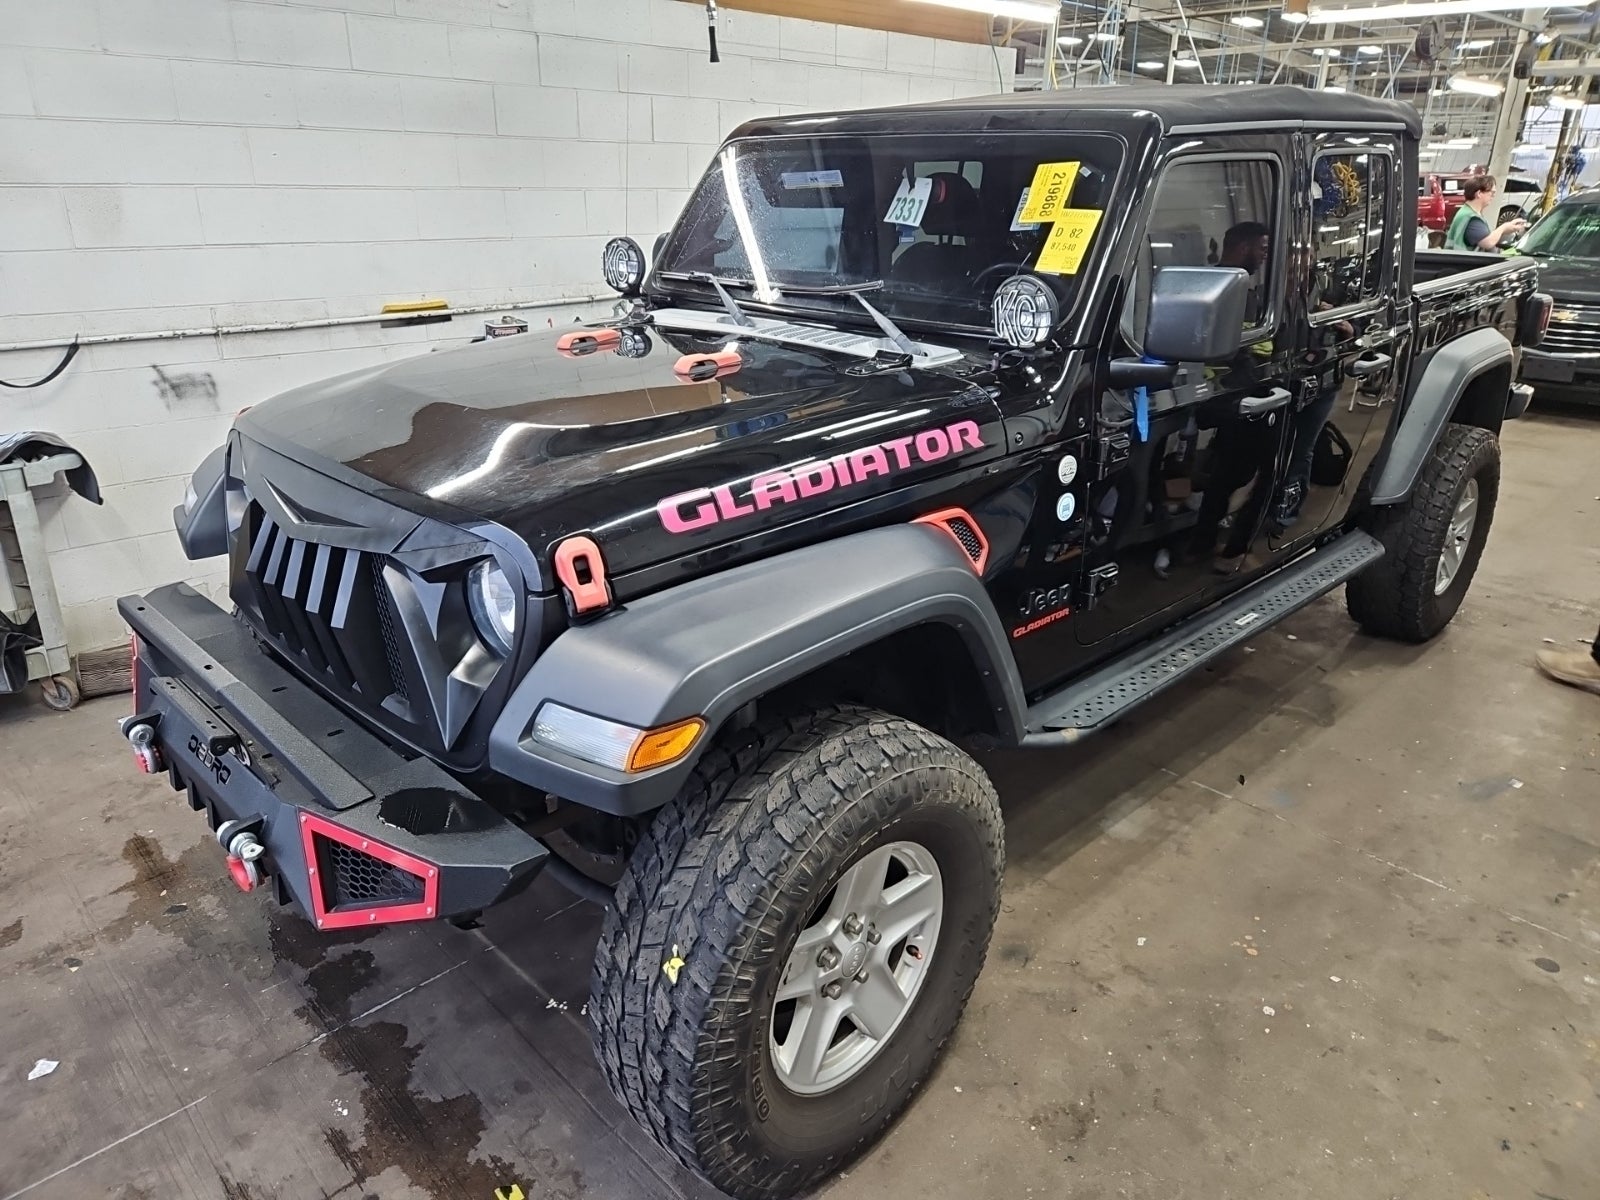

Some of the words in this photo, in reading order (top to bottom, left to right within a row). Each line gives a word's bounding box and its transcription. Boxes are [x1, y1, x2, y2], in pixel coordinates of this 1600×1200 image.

[887, 196, 924, 224] 7331
[1039, 171, 1067, 217] 219868
[1055, 227, 1064, 238] D
[1069, 227, 1084, 239] 82
[602, 242, 629, 287] KC
[994, 289, 1037, 346] KC
[656, 420, 985, 533] GLADIATOR
[1020, 583, 1070, 615] Jeep
[1013, 607, 1070, 638] GLADIATOR
